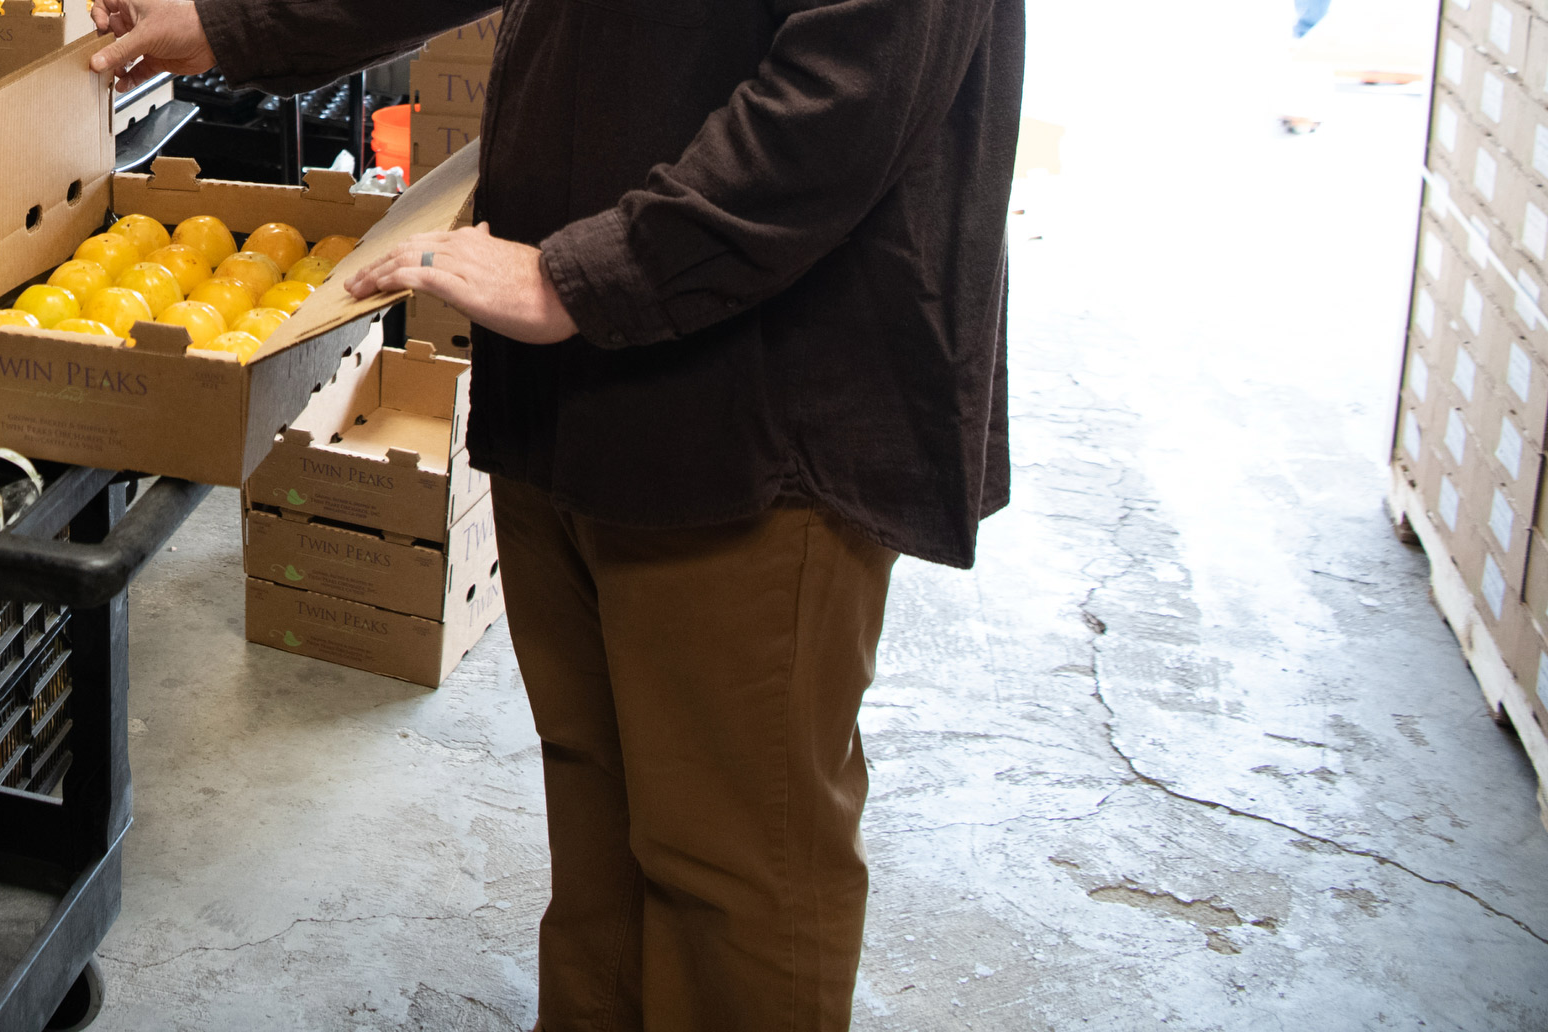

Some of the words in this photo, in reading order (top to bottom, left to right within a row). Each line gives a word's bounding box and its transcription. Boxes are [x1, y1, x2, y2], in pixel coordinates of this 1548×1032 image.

[438, 73, 486, 102] TW
[66, 360, 149, 397] PEAKS
[299, 457, 341, 479] TWIN
[348, 467, 394, 490] PEAKS
[297, 533, 339, 556] TWIN
[346, 544, 392, 567] PEAKS
[464, 509, 493, 561] TWI
[295, 600, 337, 623] TWIN
[343, 611, 388, 635] PEAKS
